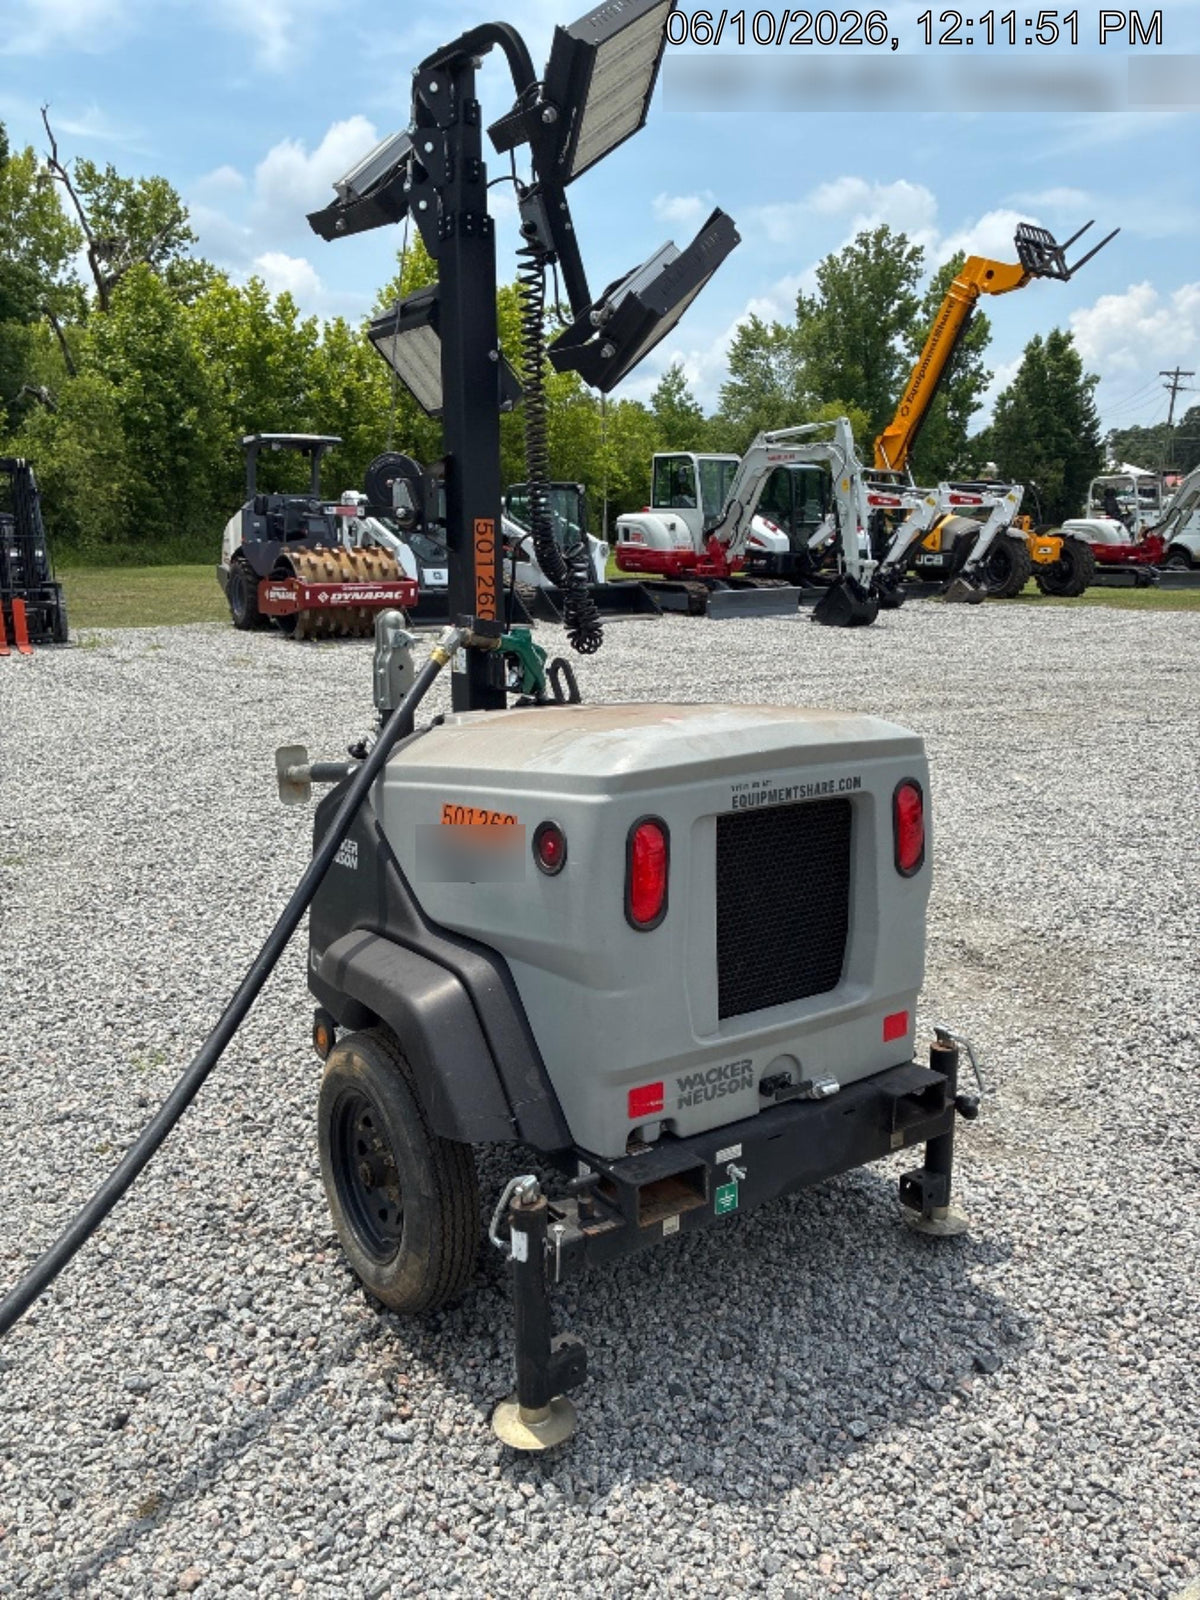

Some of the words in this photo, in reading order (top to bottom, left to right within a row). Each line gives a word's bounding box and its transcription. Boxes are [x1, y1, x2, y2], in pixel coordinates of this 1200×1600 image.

[475, 521, 495, 620] 501260
[915, 554, 943, 565] JCB
[330, 590, 403, 600] DYNAPAC
[732, 776, 862, 809] EQUIPMENTSHARE.COM
[676, 1058, 753, 1093] WACKER
[677, 1074, 753, 1110] NEUSON
